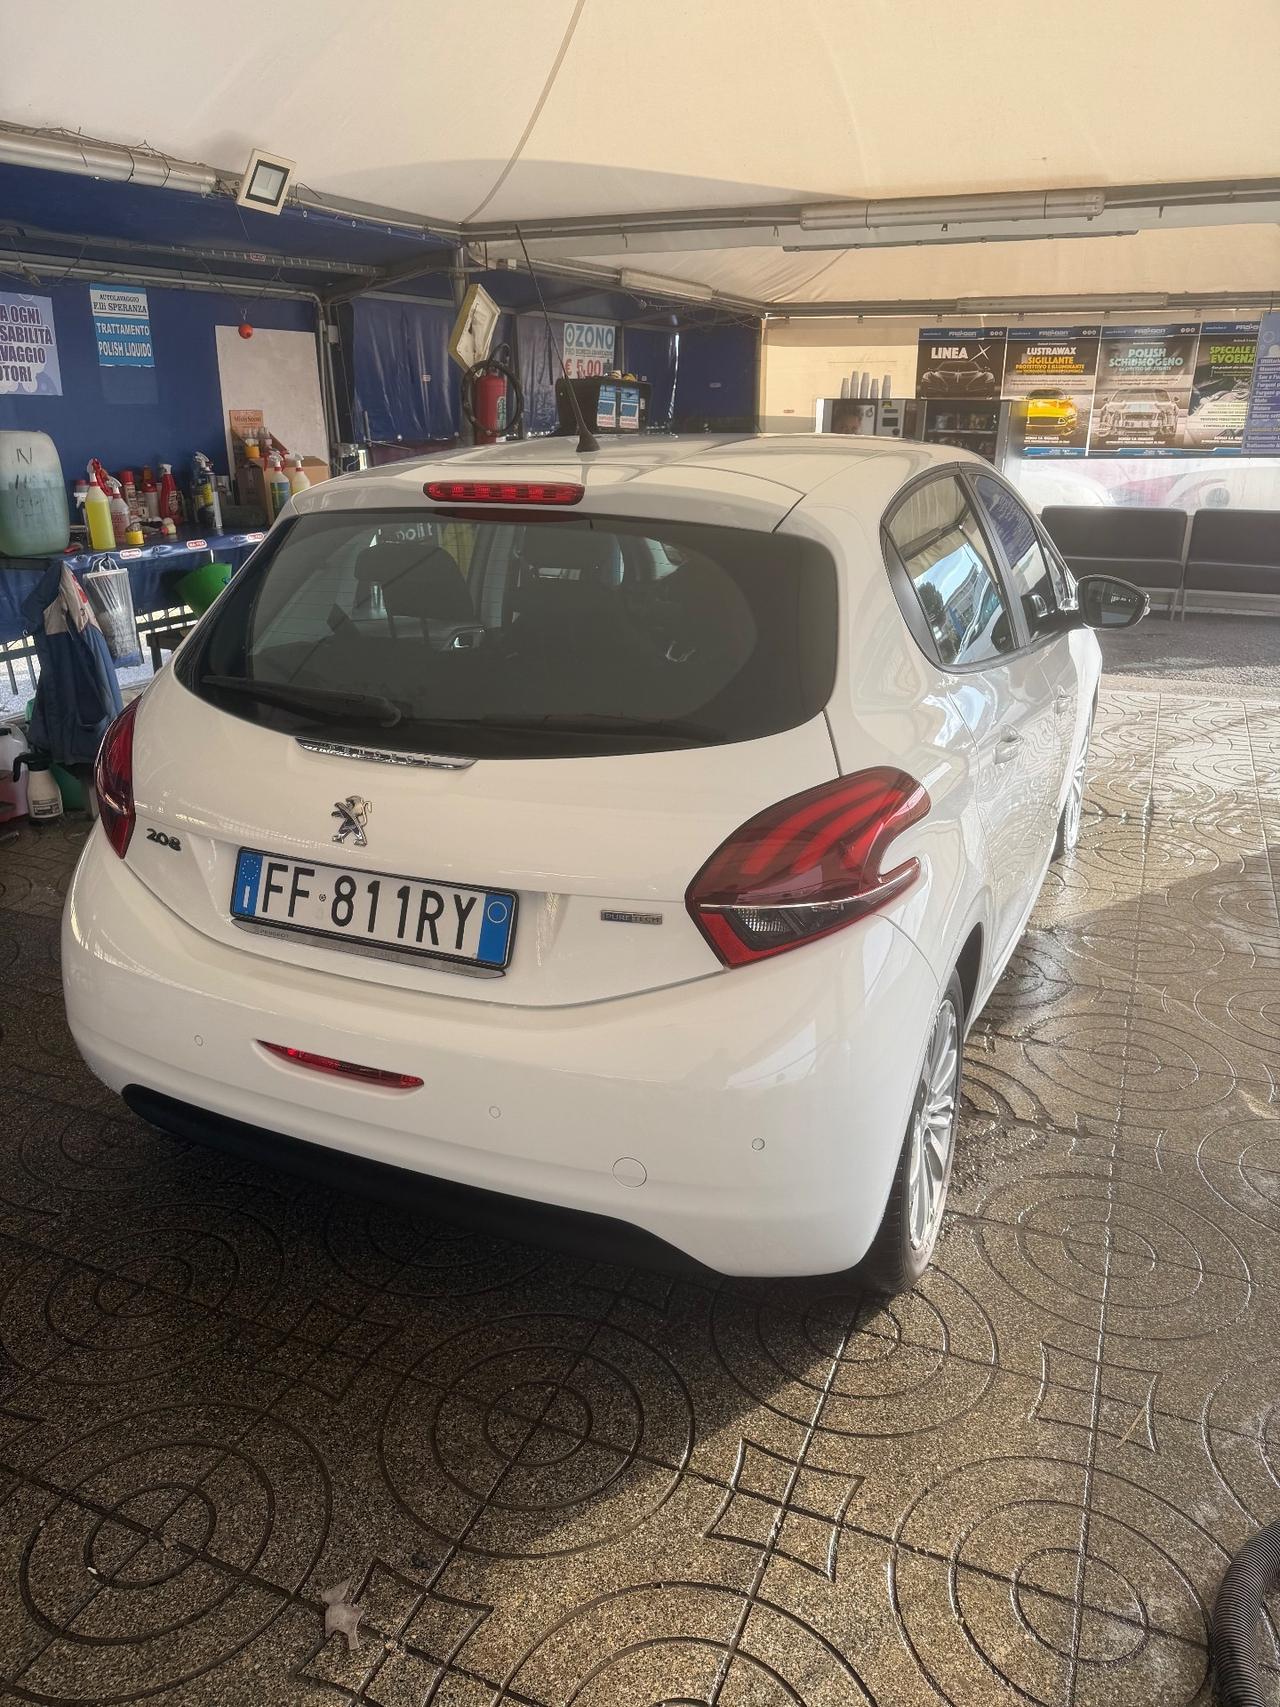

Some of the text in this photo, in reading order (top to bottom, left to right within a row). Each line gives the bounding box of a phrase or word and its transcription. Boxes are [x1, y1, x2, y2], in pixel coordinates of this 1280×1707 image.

[100, 293, 140, 302] AUTOLAVAGGIO
[108, 303, 147, 313] SPERANZA
[10, 305, 41, 326] OGNI
[96, 322, 150, 336] TRATTAMENTO
[565, 323, 614, 349] OZONO
[99, 341, 152, 357] POLISH LIQUIDO
[931, 347, 969, 359] LINEA
[1026, 347, 1077, 355] LUSTRAWAX
[1128, 348, 1167, 358] POLISH
[1209, 346, 1250, 354] SPECIALE
[1027, 356, 1074, 364] SIGILLANTE
[145, 828, 182, 852] 208
[261, 862, 316, 918] FF
[330, 874, 478, 951] 811RY
